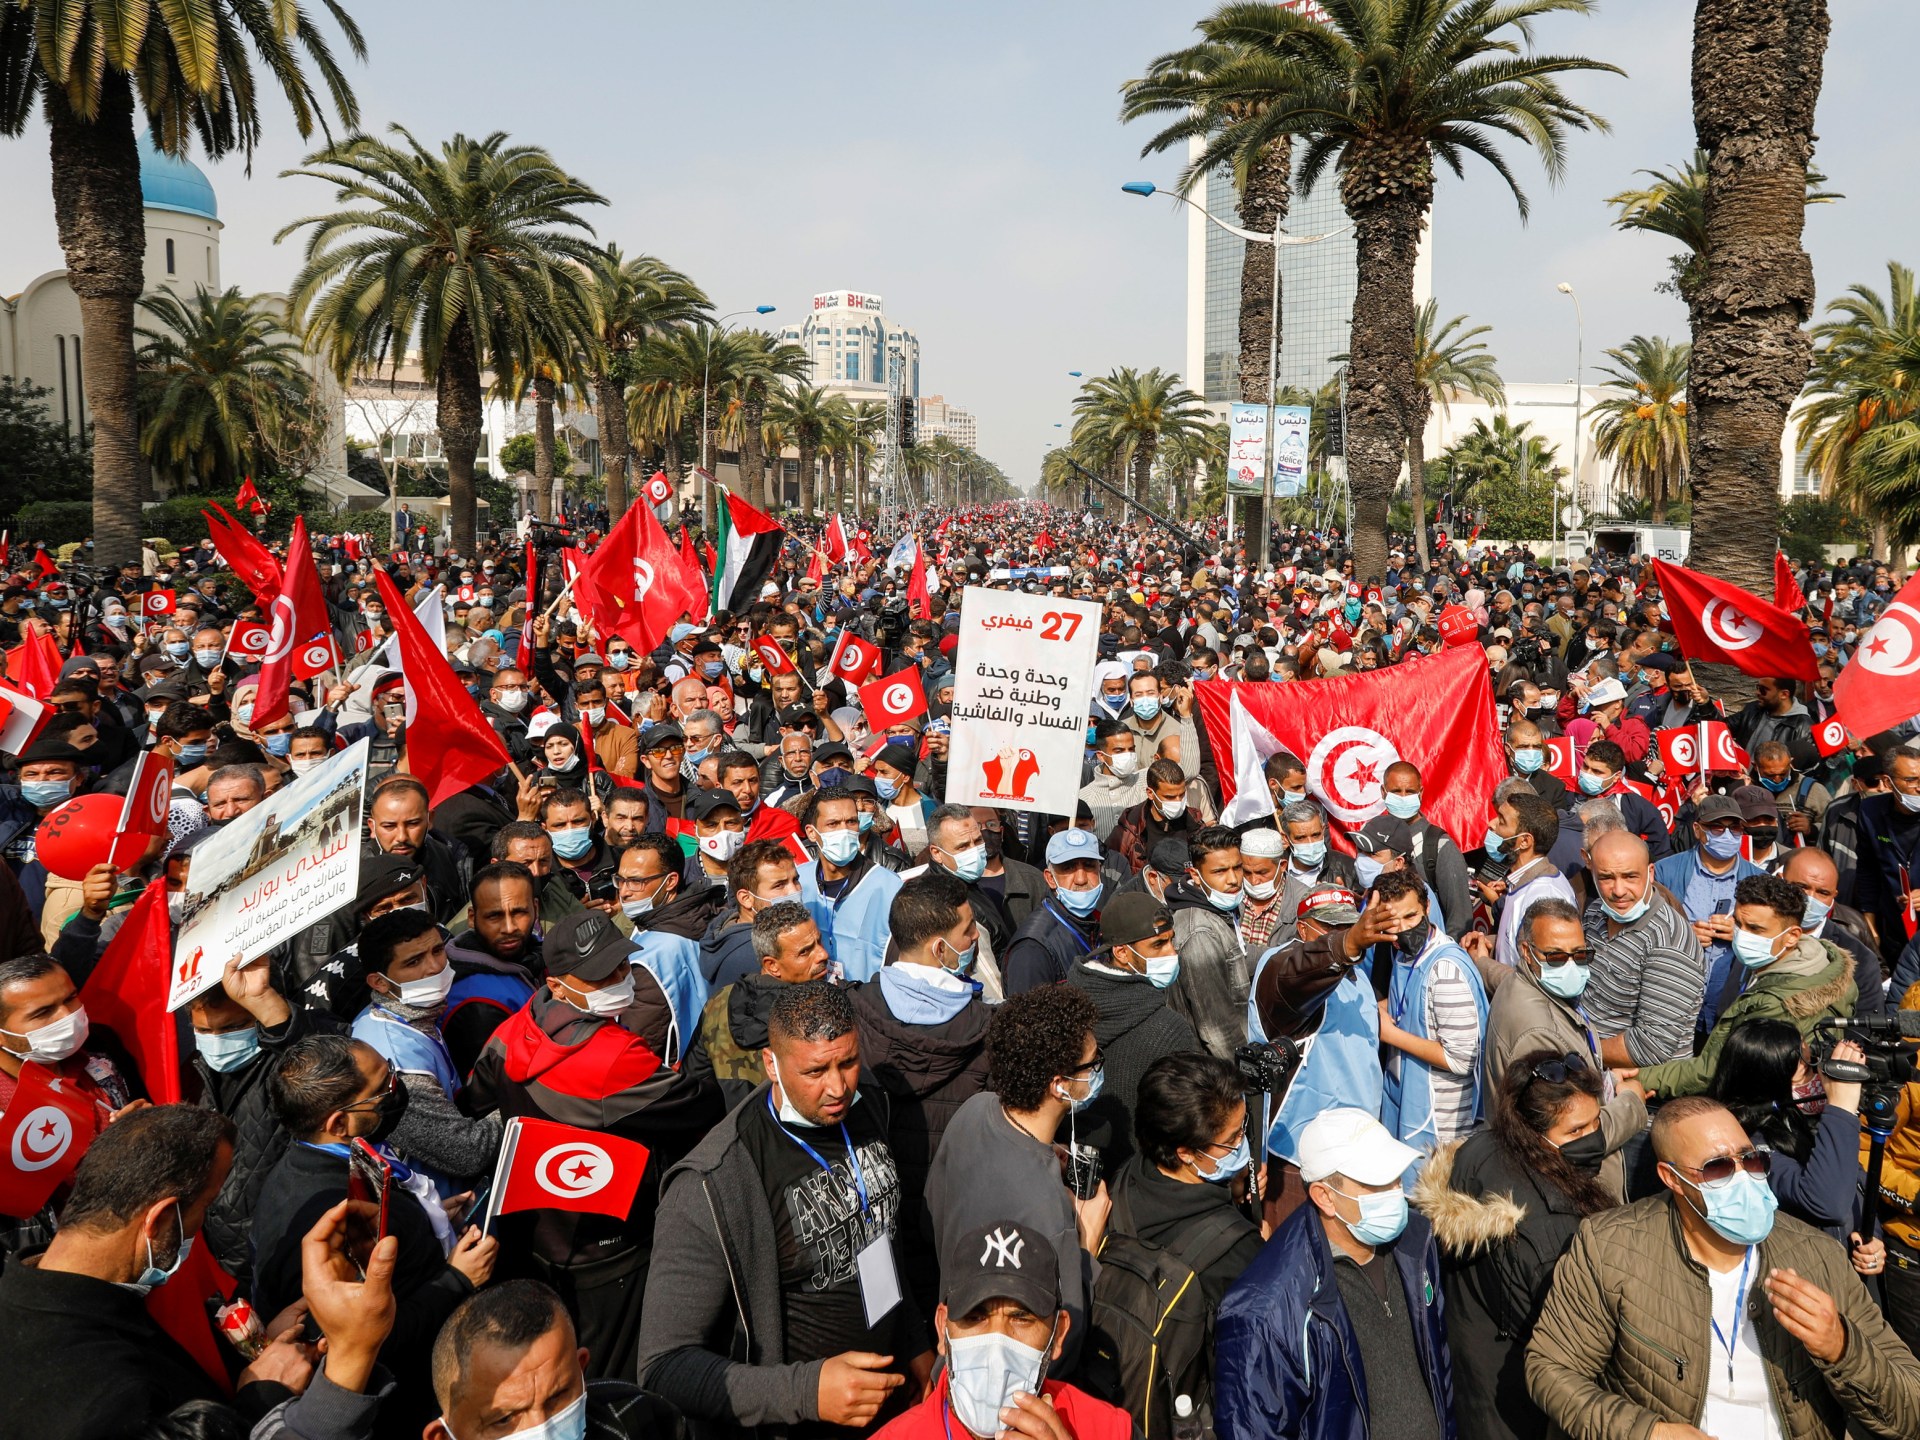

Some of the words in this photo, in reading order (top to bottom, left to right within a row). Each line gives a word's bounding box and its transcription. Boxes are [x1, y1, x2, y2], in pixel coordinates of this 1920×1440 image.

[814, 296, 826, 310] BH
[847, 293, 863, 309] BH
[1235, 415, 1264, 426] دليس
[1278, 417, 1307, 427] دليس
[1233, 434, 1263, 447] صفي
[1658, 549, 1678, 560] PSL
[981, 613, 1033, 632] فيفري
[1040, 611, 1083, 642] 27
[976, 662, 1020, 684] وحدة
[1025, 668, 1068, 690] وحدة
[978, 685, 1004, 700] ضد
[1009, 687, 1061, 711] وطنية
[952, 702, 1024, 727] والفاشية
[1028, 711, 1082, 732] الفساد
[286, 834, 348, 887] سيدي
[313, 859, 349, 889] تشارك
[238, 875, 280, 913] بوزيد
[291, 884, 310, 903] في
[307, 882, 346, 915] والدفاع
[255, 898, 288, 925] مسيرة
[289, 906, 304, 924] عن
[189, 975, 203, 992] 27
[1836, 1064, 1860, 1073] Canon
[980, 1226, 1025, 1269] NY
